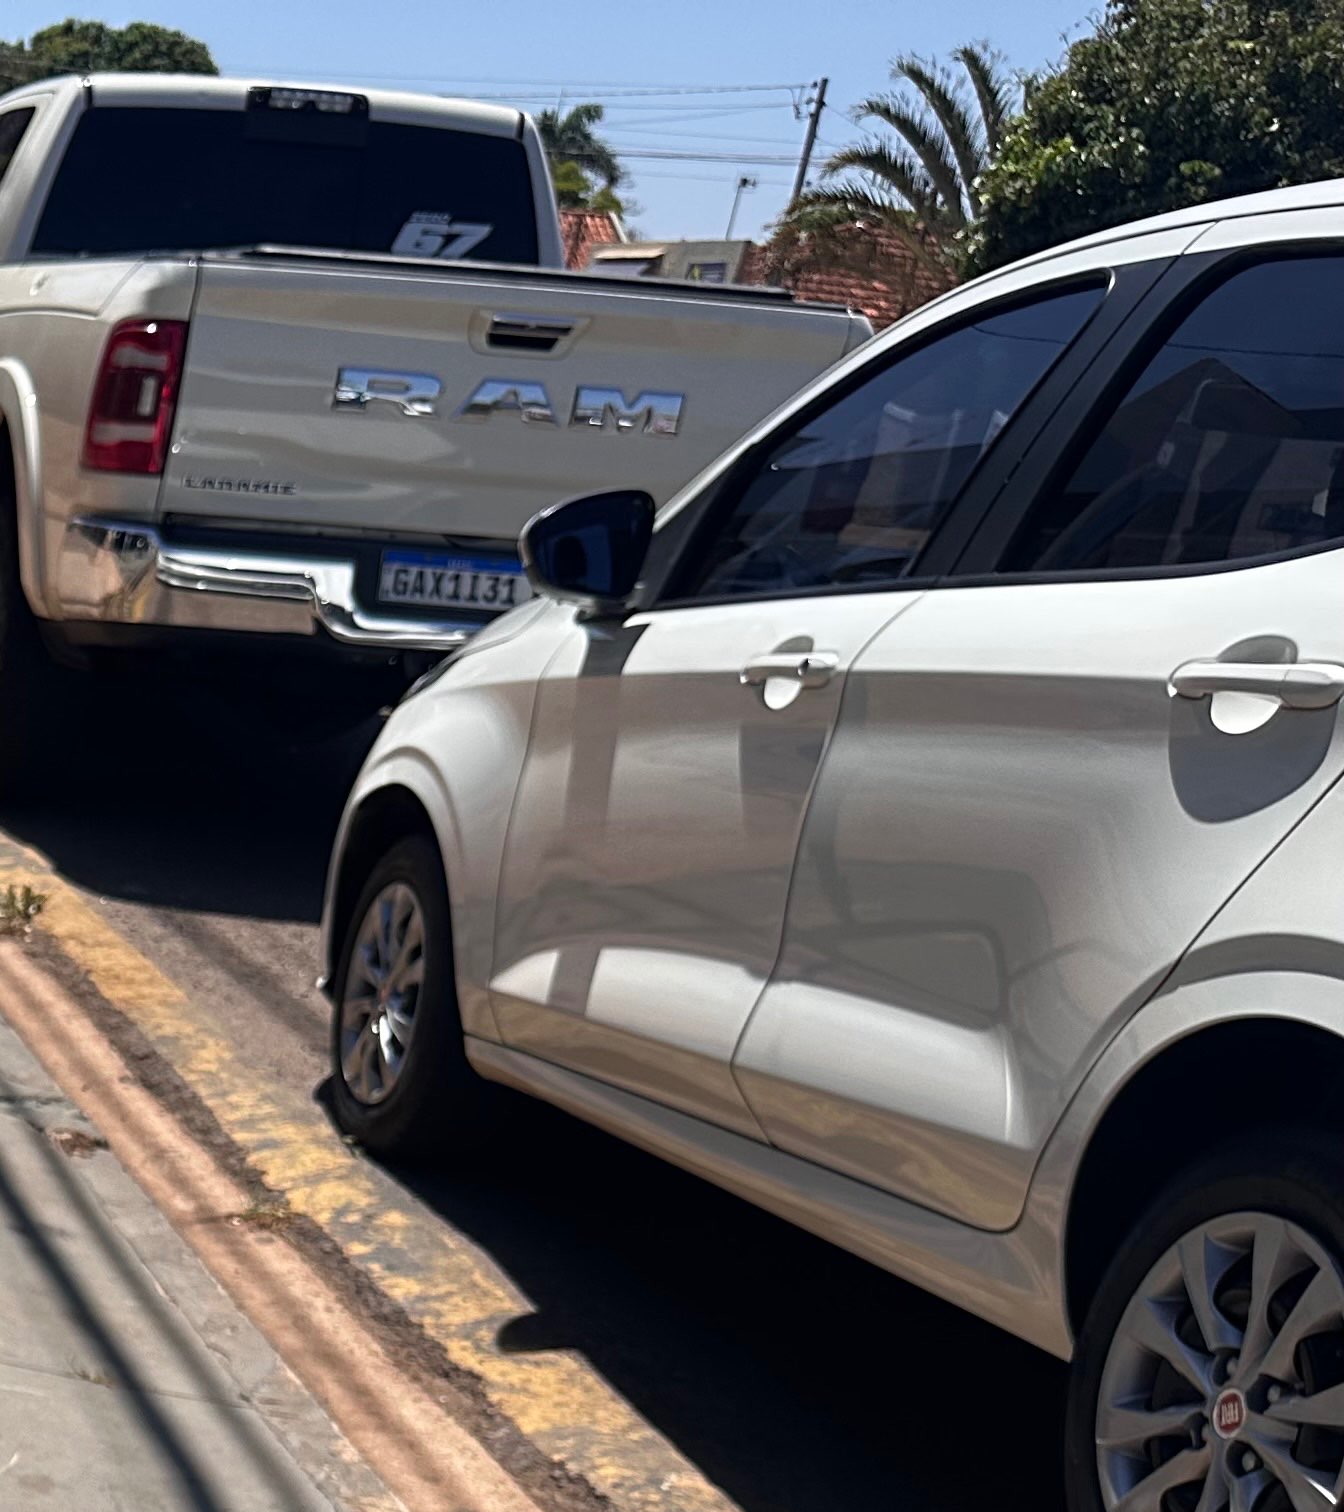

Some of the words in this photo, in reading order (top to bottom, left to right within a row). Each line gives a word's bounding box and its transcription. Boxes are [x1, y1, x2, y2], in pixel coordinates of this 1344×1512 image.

[391, 222, 493, 258] 67
[331, 366, 686, 439] RAM
[392, 568, 517, 605] GAX1I31
